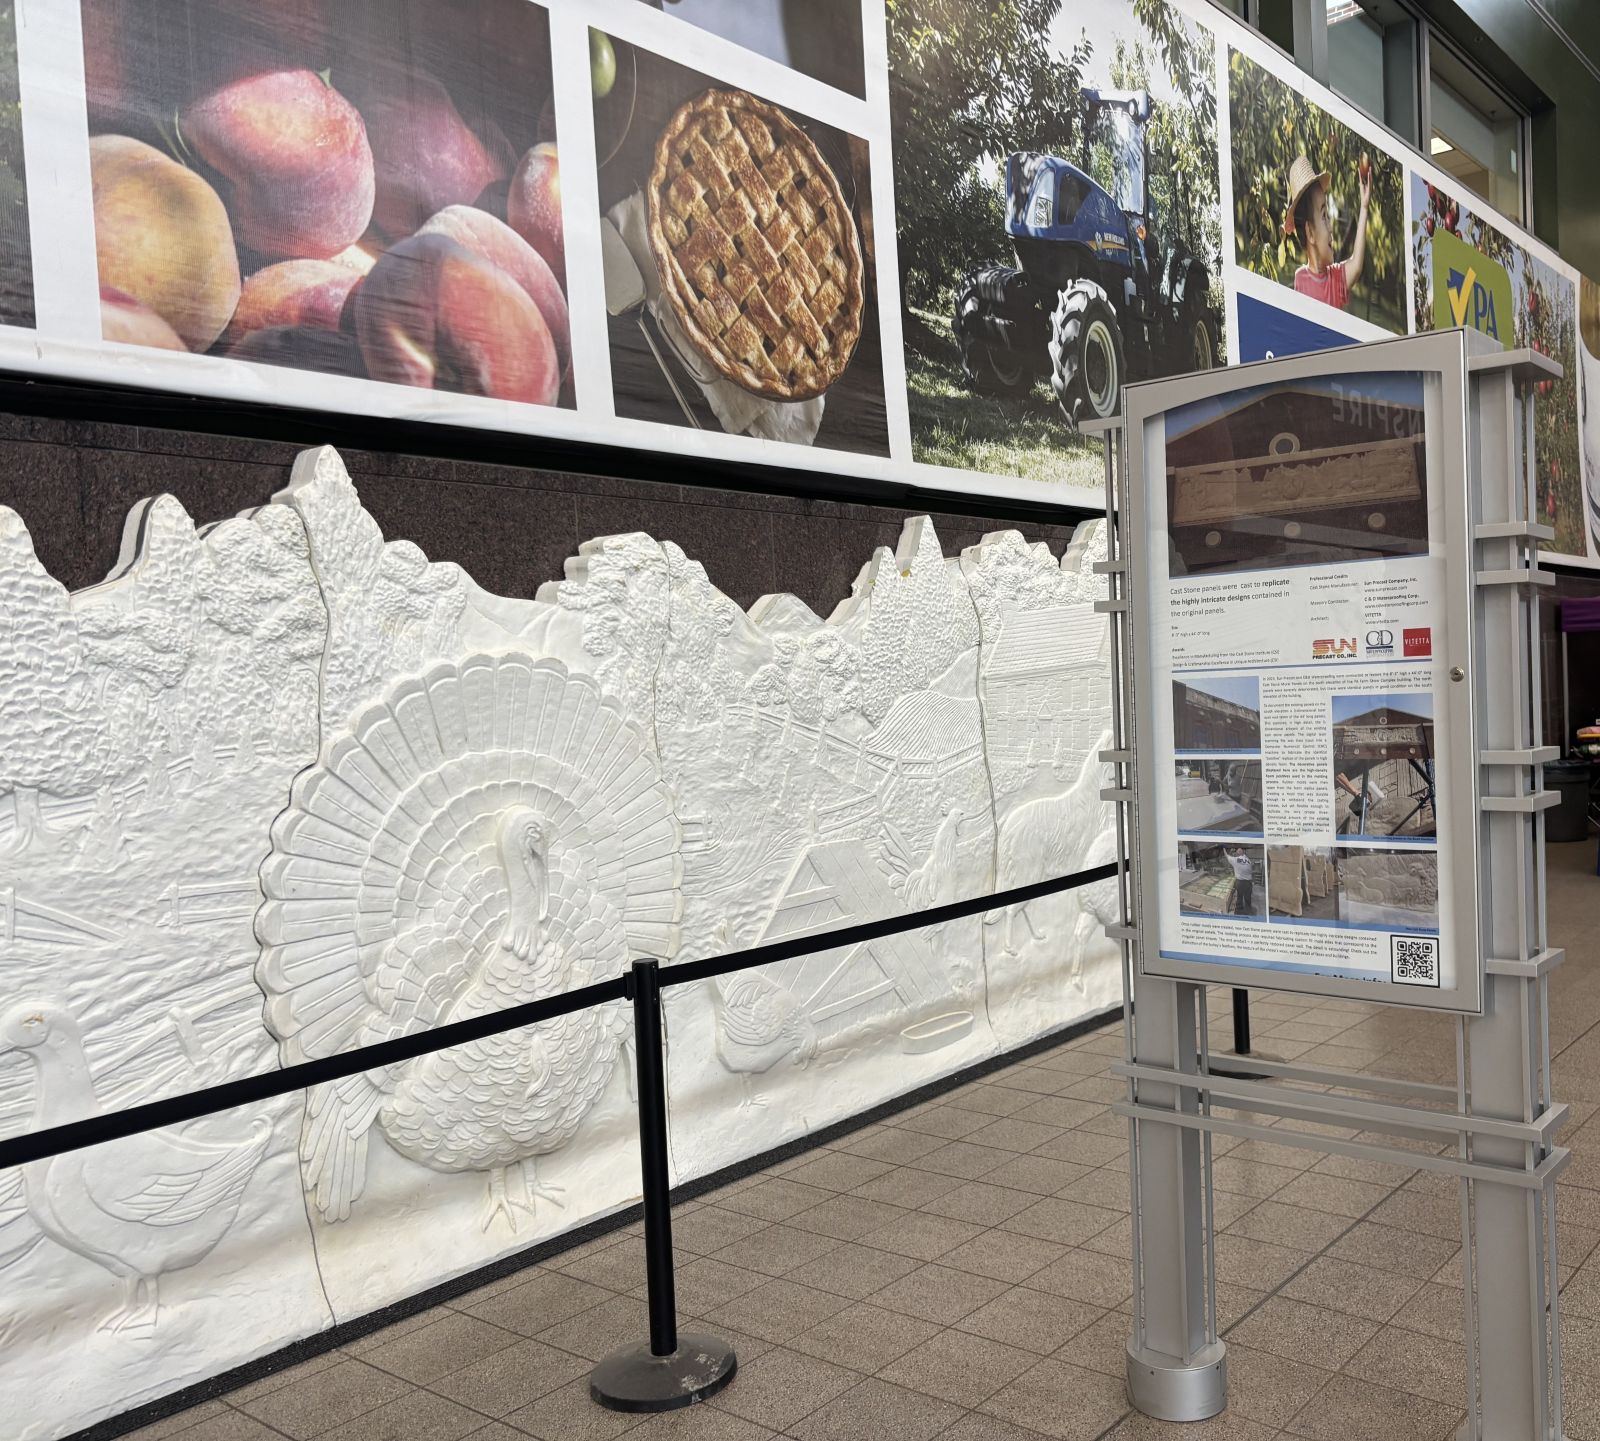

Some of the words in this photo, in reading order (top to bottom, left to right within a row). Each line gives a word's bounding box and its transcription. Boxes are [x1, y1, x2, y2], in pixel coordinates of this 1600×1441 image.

[1473, 281, 1499, 340] PA
[1262, 579, 1290, 588] replicate
[1227, 594, 1250, 602] designs
[1252, 591, 1282, 600] contained
[1182, 609, 1204, 617] original
[1204, 607, 1226, 616] panels.
[1312, 638, 1357, 654] SUN
